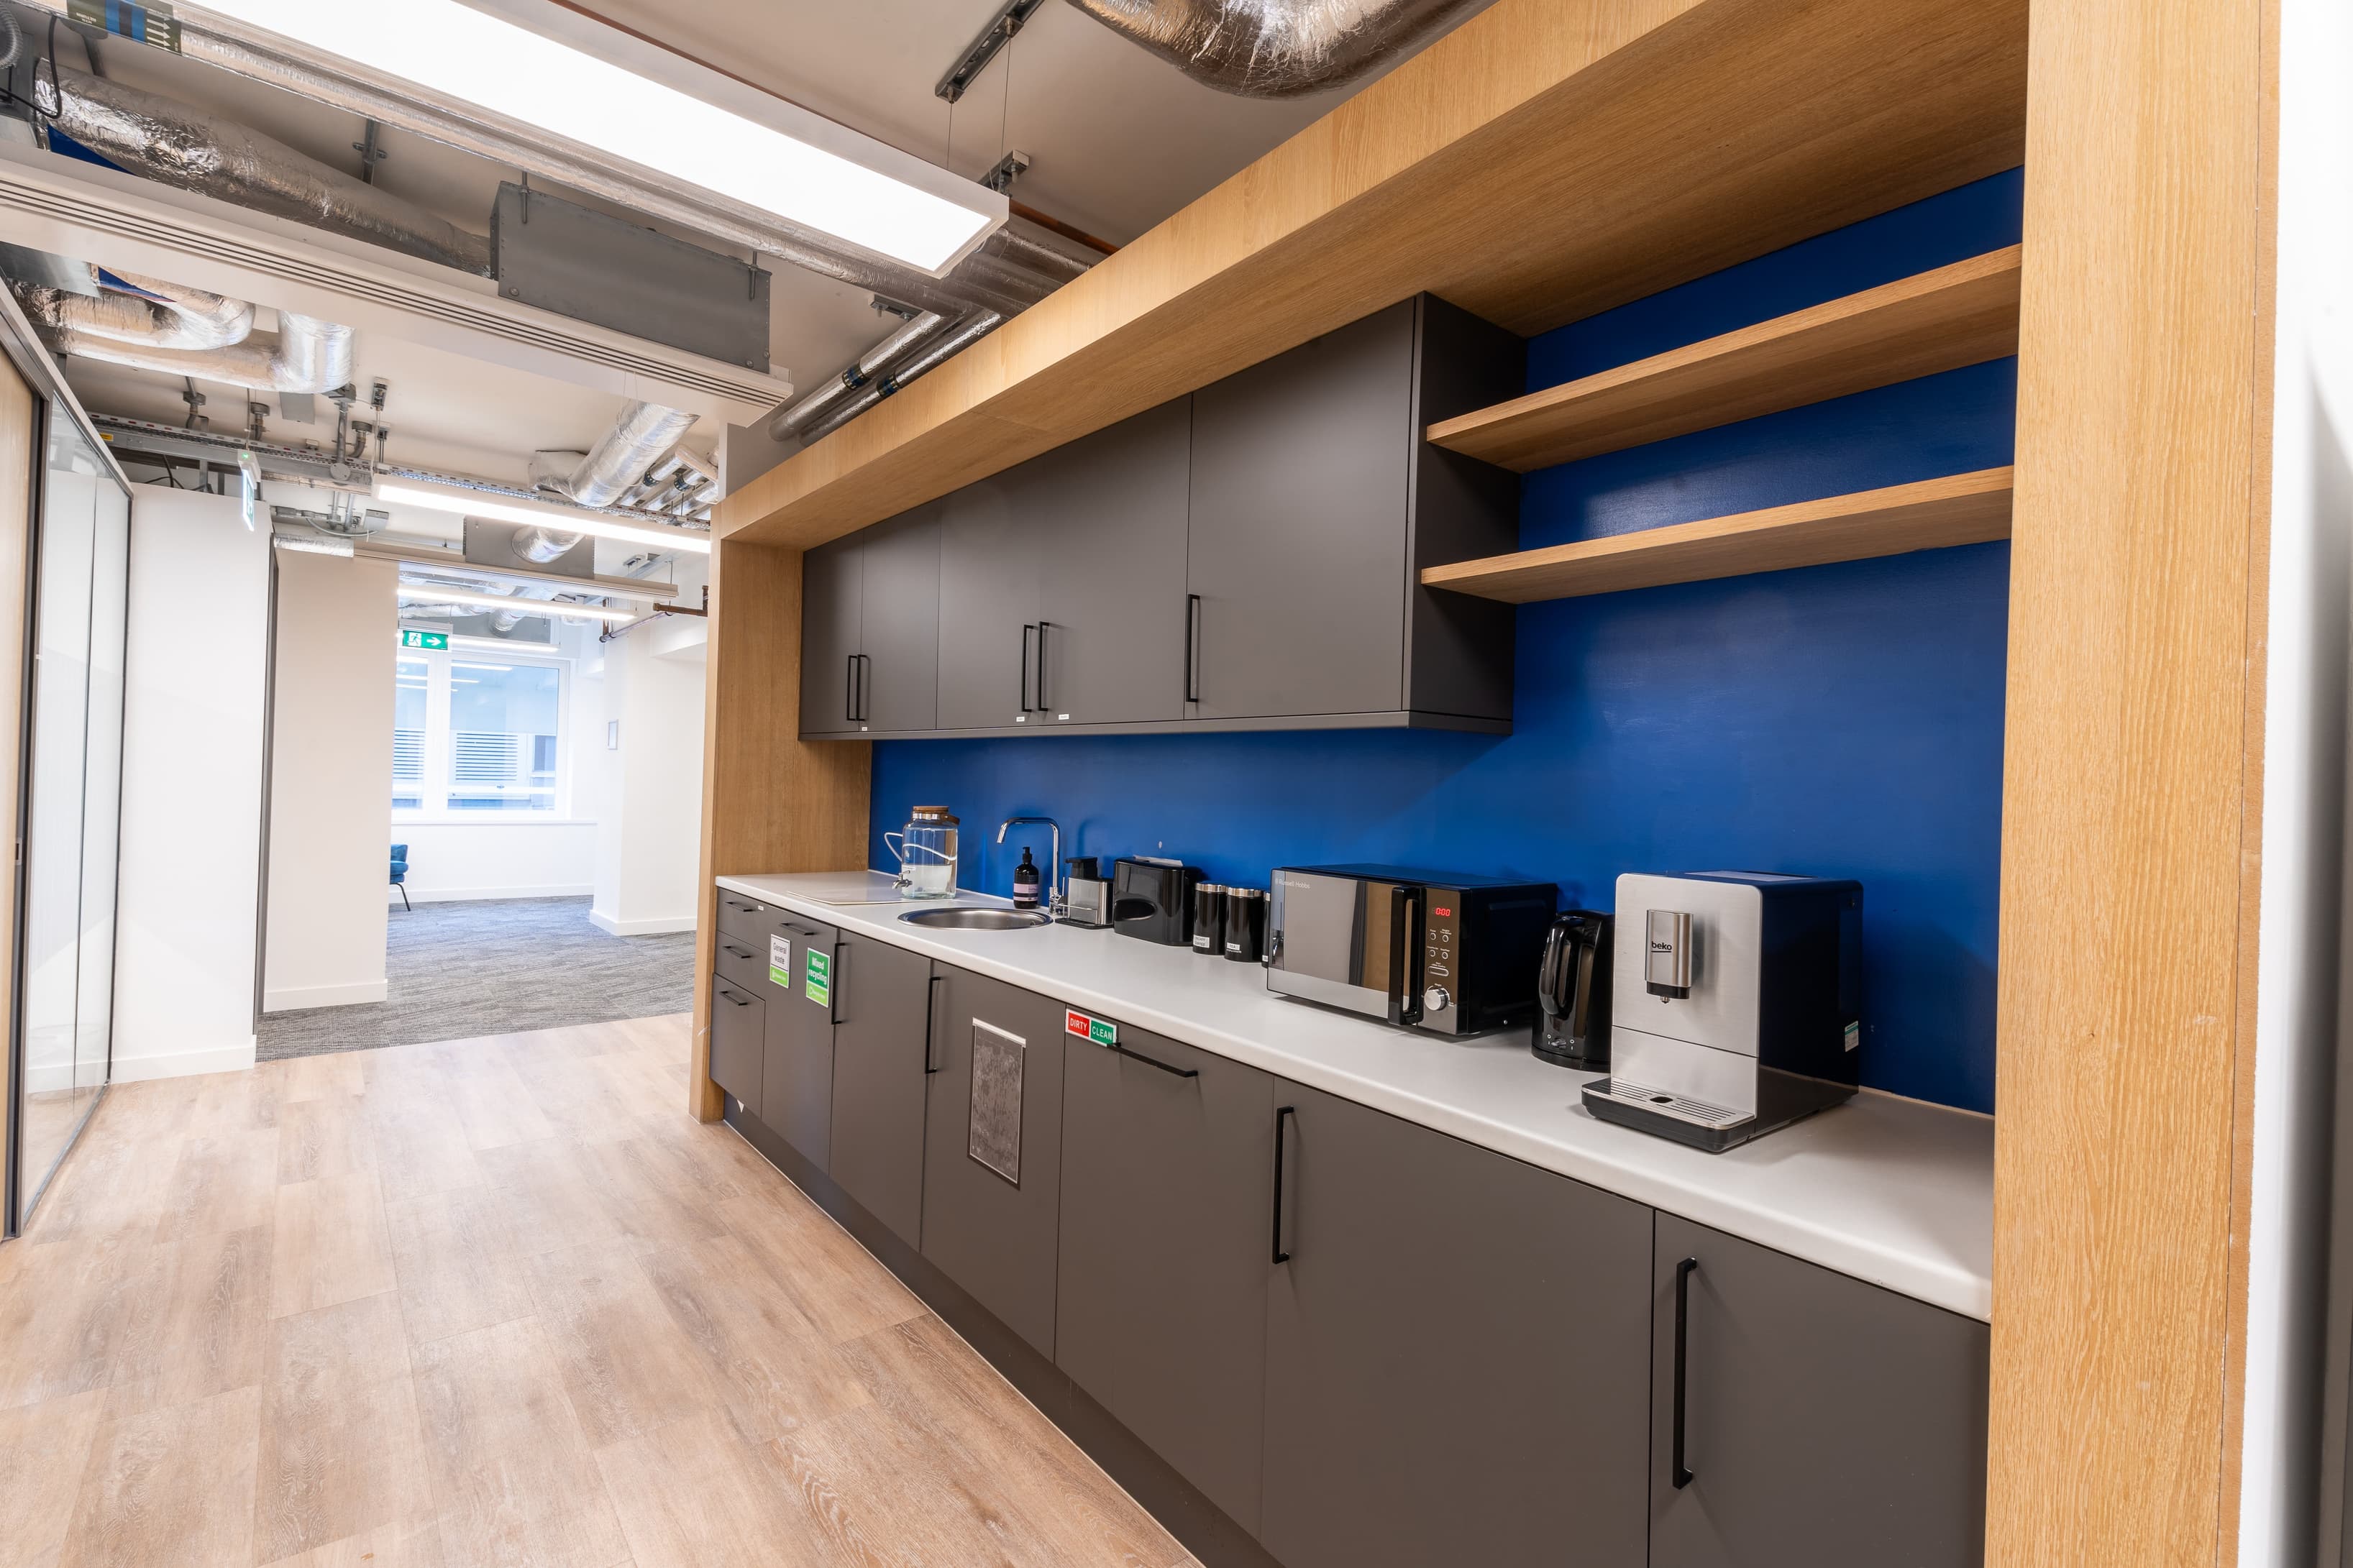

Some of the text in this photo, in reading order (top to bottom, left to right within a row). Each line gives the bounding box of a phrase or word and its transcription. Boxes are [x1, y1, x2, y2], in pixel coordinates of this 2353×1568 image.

[1435, 907, 1450, 917] 0:00
[773, 943, 787, 955] General
[1651, 940, 1672, 950] beko
[775, 956, 785, 965] waste
[812, 957, 825, 970] Mixed
[808, 968, 828, 985] recycling
[1070, 1018, 1112, 1040] DIRTY CLEAN
